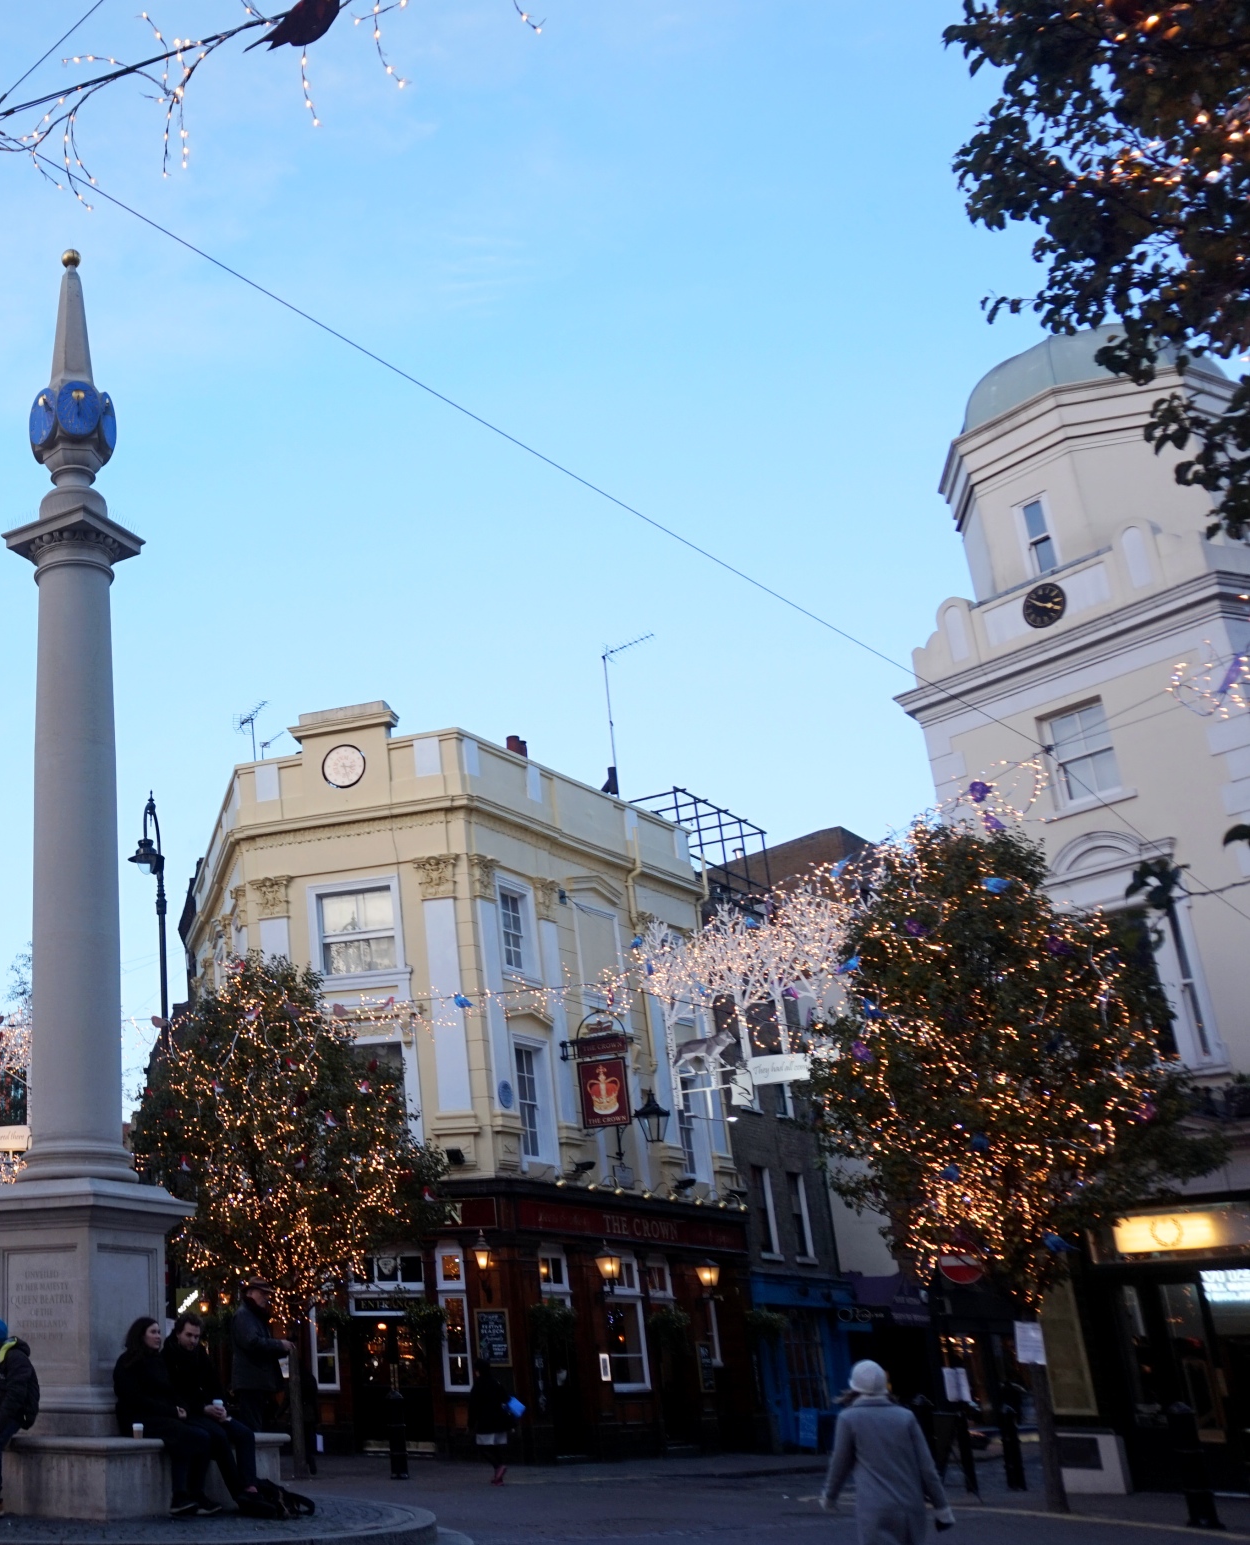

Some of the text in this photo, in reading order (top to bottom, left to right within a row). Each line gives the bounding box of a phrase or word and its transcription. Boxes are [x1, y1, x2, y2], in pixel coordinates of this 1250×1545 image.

[597, 1041, 622, 1050] CROWN
[753, 1063, 770, 1078] They
[771, 1061, 784, 1072] had
[602, 1115, 627, 1123] CROWN
[602, 1213, 630, 1236] THE
[632, 1217, 678, 1240] CROWN
[24, 1270, 59, 1279] UNVEILED
[25, 1282, 38, 1291] HER
[39, 1281, 69, 1291] MAJESTY
[11, 1293, 74, 1309] QUEEN BEATRIX
[360, 1299, 416, 1310] ENTRANC
[30, 1307, 53, 1317] OF THE
[16, 1319, 69, 1328] NETHERLANDS
